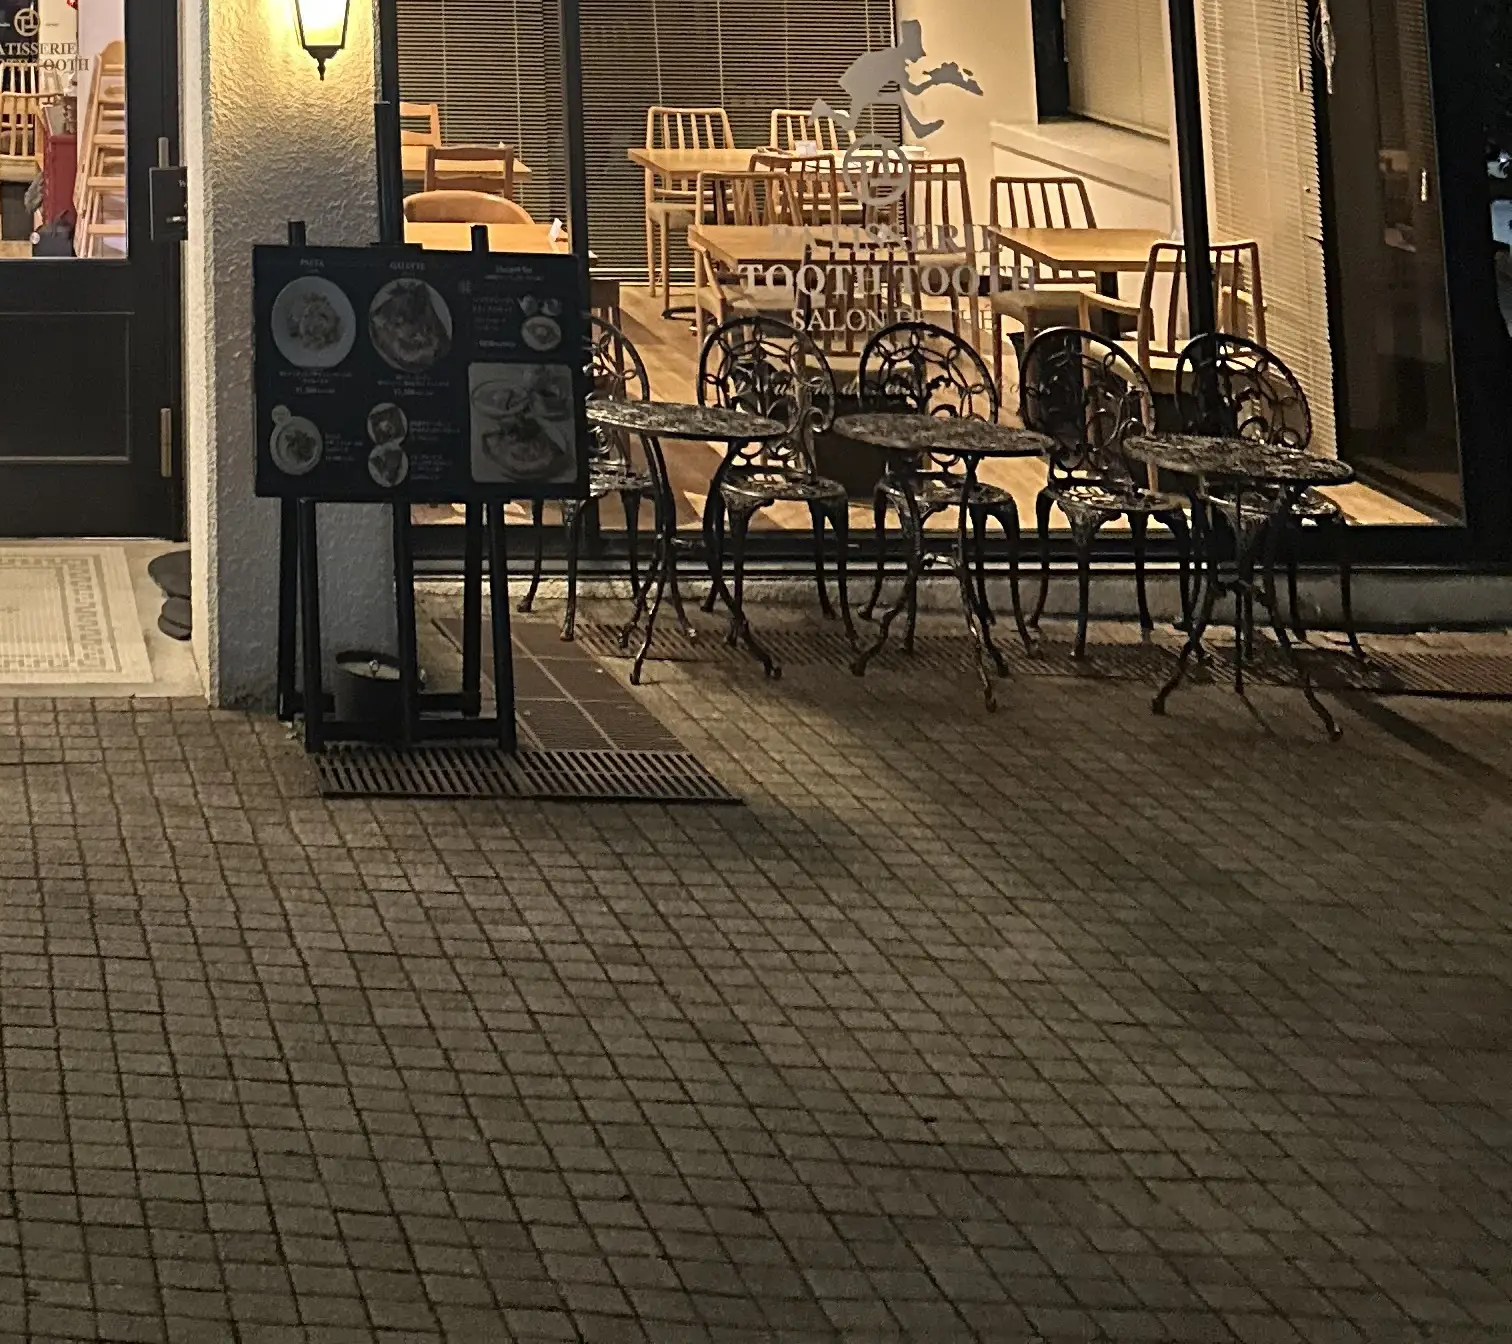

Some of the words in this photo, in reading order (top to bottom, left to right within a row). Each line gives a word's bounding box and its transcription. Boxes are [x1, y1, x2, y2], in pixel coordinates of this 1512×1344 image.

[772, 223, 1003, 254] PATISSERIE
[738, 264, 881, 295] TOOTH
[893, 265, 1039, 296] TOOTH
[792, 309, 887, 332] SALON
